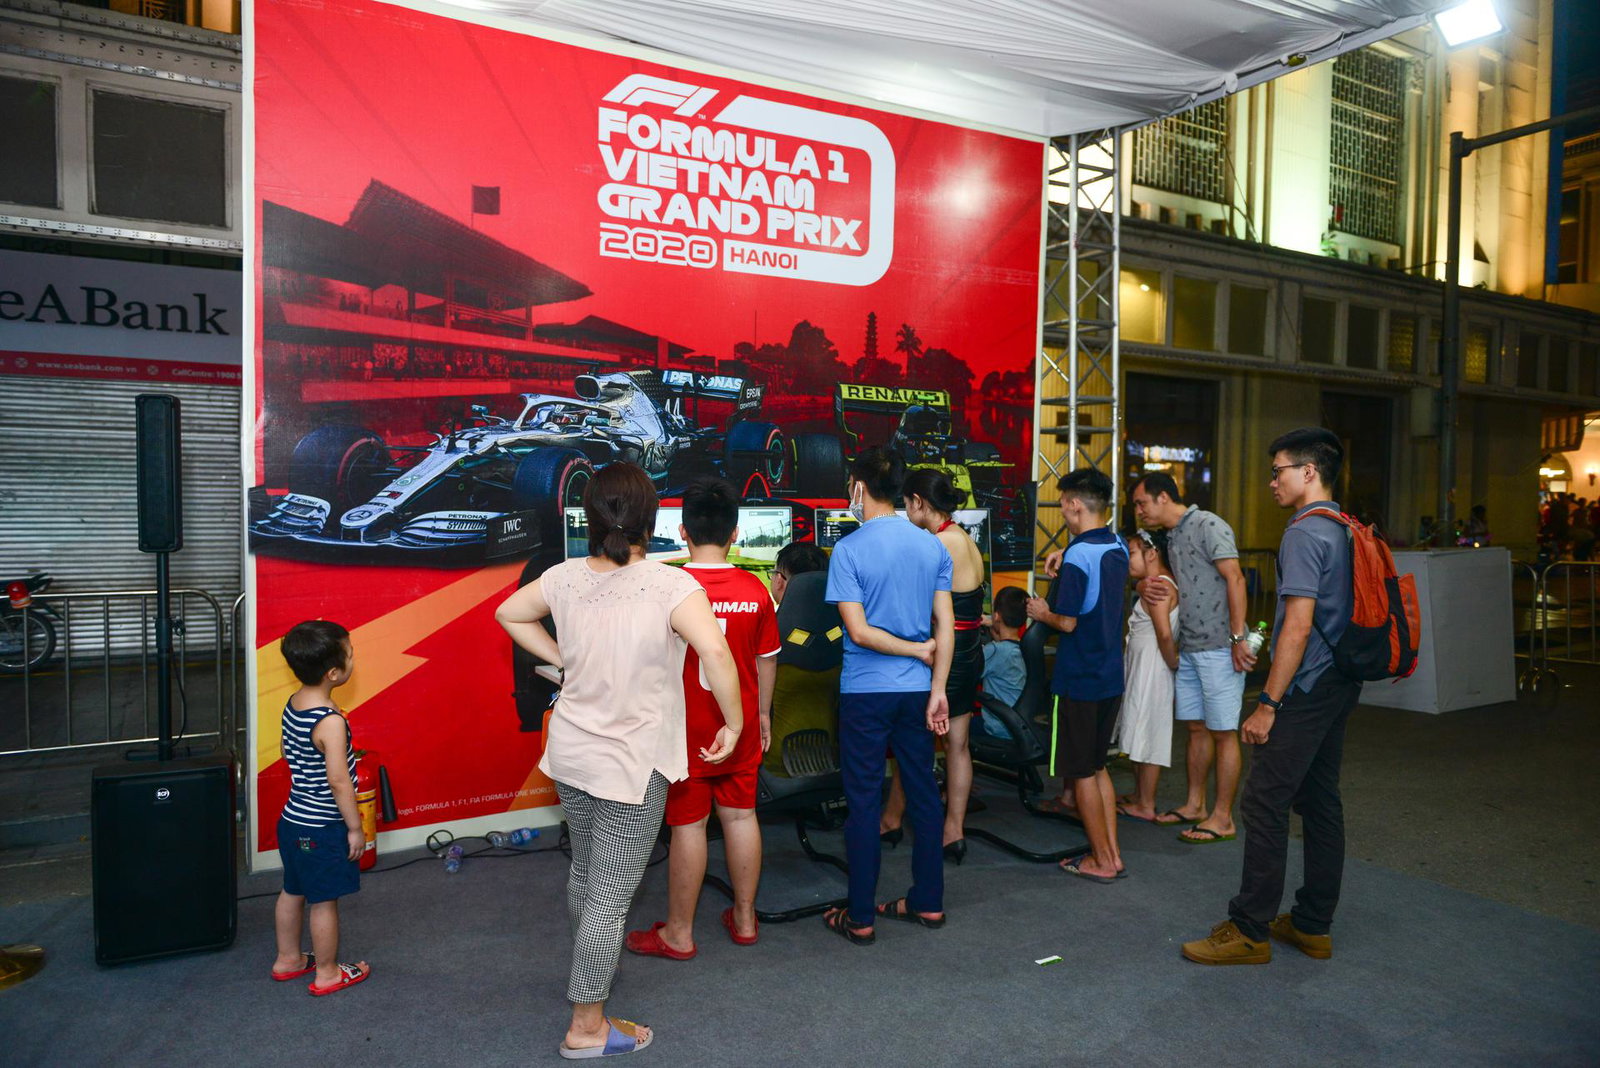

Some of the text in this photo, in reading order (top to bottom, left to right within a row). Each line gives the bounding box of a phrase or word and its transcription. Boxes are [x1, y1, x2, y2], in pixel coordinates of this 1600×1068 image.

[598, 106, 849, 183] FORMULA 1
[598, 143, 814, 211] VIETNAM
[597, 182, 863, 250] GRAND PRIX
[599, 221, 718, 268] 2020
[730, 247, 798, 270] HANOI
[503, 518, 522, 534] IWC
[415, 802, 450, 813] FORMULA
[470, 796, 480, 804] FIA
[481, 791, 514, 803] FORMULA
[514, 789, 529, 798] ONE
